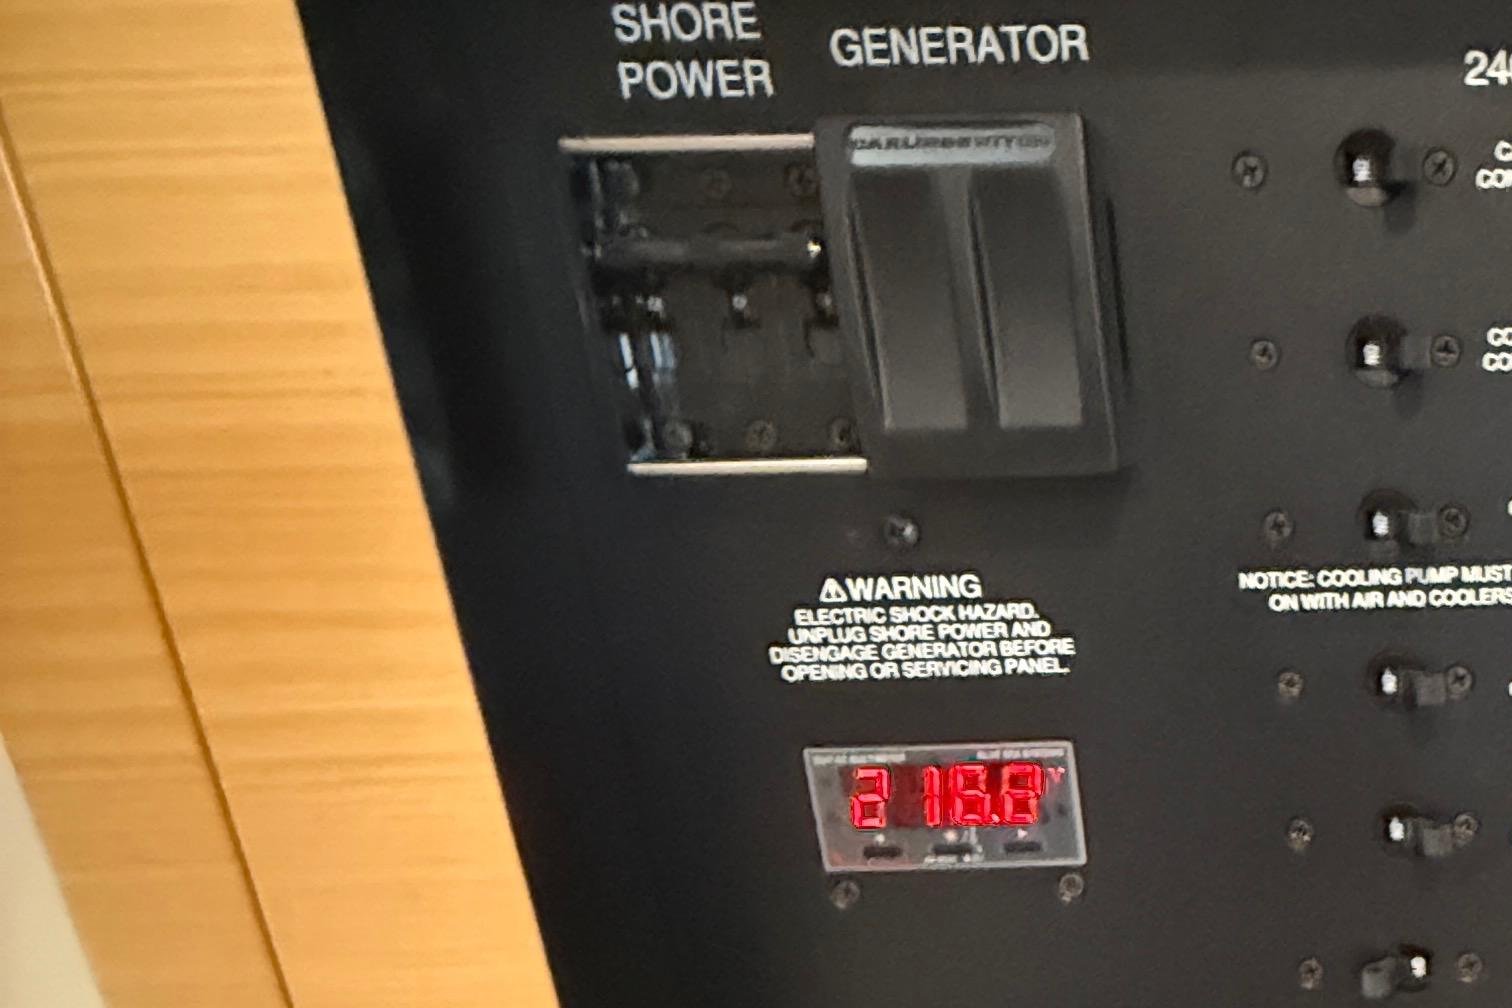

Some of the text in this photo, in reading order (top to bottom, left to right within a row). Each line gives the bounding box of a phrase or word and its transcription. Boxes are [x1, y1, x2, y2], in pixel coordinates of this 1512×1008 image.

[611, 1, 762, 43] SHORE
[829, 24, 1090, 67] GENERATOR
[617, 58, 774, 100] POWER
[844, 573, 983, 602] WARNING
[1238, 569, 1316, 590] NOTICE:
[1316, 567, 1403, 588] COOLING
[1404, 565, 1460, 585] PUMP
[1268, 593, 1300, 612] ON
[1299, 591, 1350, 611] WITH
[1351, 590, 1385, 609] AIR
[1386, 589, 1427, 608] AND
[794, 602, 1040, 628] ELECTRIC SHOCK HAZARD.
[787, 620, 1052, 645] UNPLUG SHORE POWER AND
[769, 637, 1076, 666] DISENGAGE GENERATOR BEFORE
[781, 656, 1071, 683] OPENING OR SERVICING PANEL.
